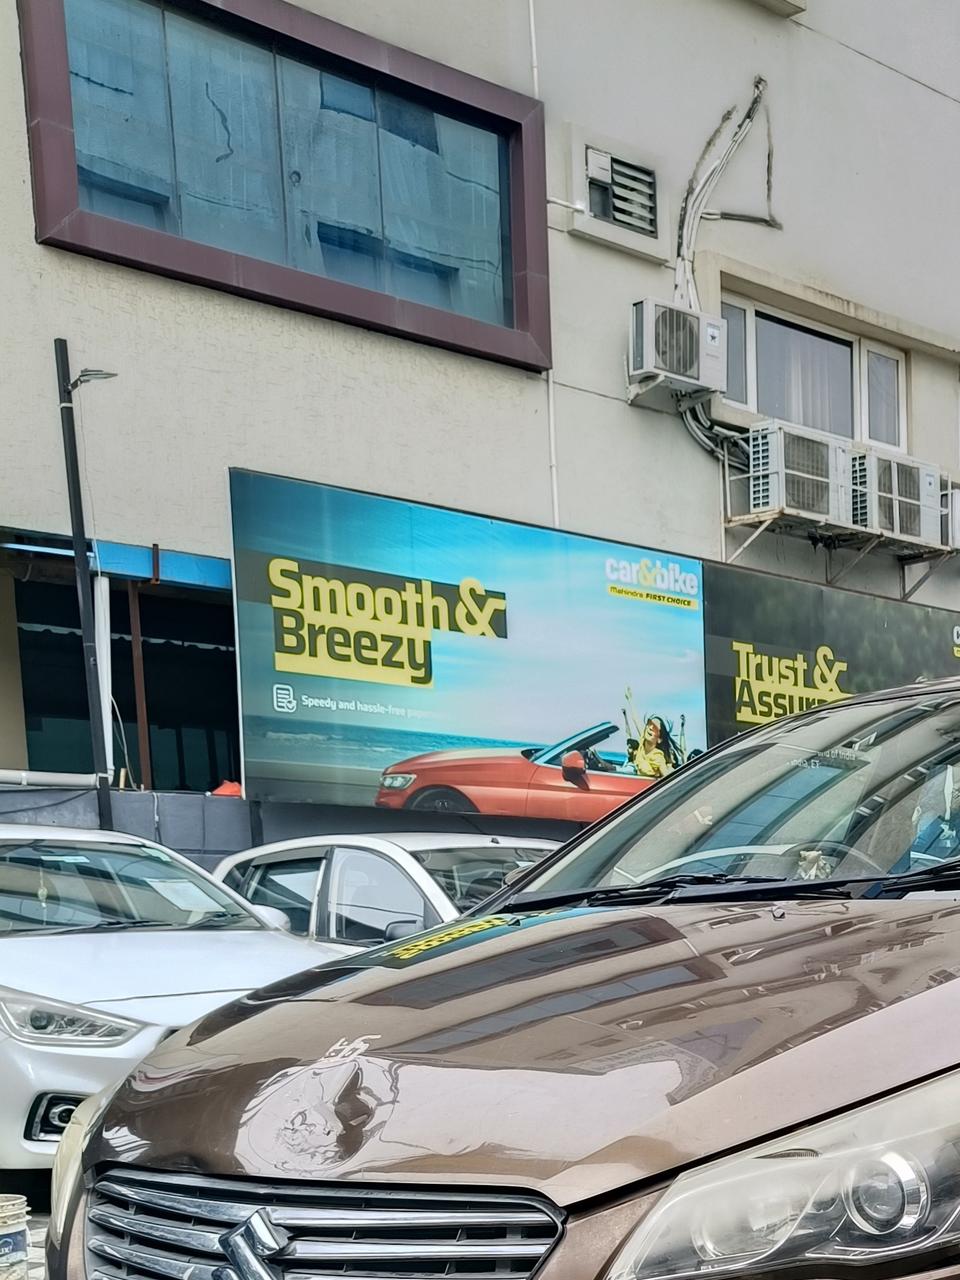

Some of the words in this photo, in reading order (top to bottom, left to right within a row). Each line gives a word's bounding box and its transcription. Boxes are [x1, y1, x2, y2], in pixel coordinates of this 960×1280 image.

[268, 558, 449, 631] Smooth
[455, 577, 507, 637] &
[606, 558, 698, 595] car&bike
[645, 592, 665, 602] FIRST
[666, 596, 692, 607] CHOICE
[274, 608, 433, 685] Breezy
[732, 641, 807, 688] Trust
[813, 645, 848, 693] &
[301, 695, 336, 711] Speedy
[338, 699, 355, 710] and
[356, 701, 406, 717] hassle-free
